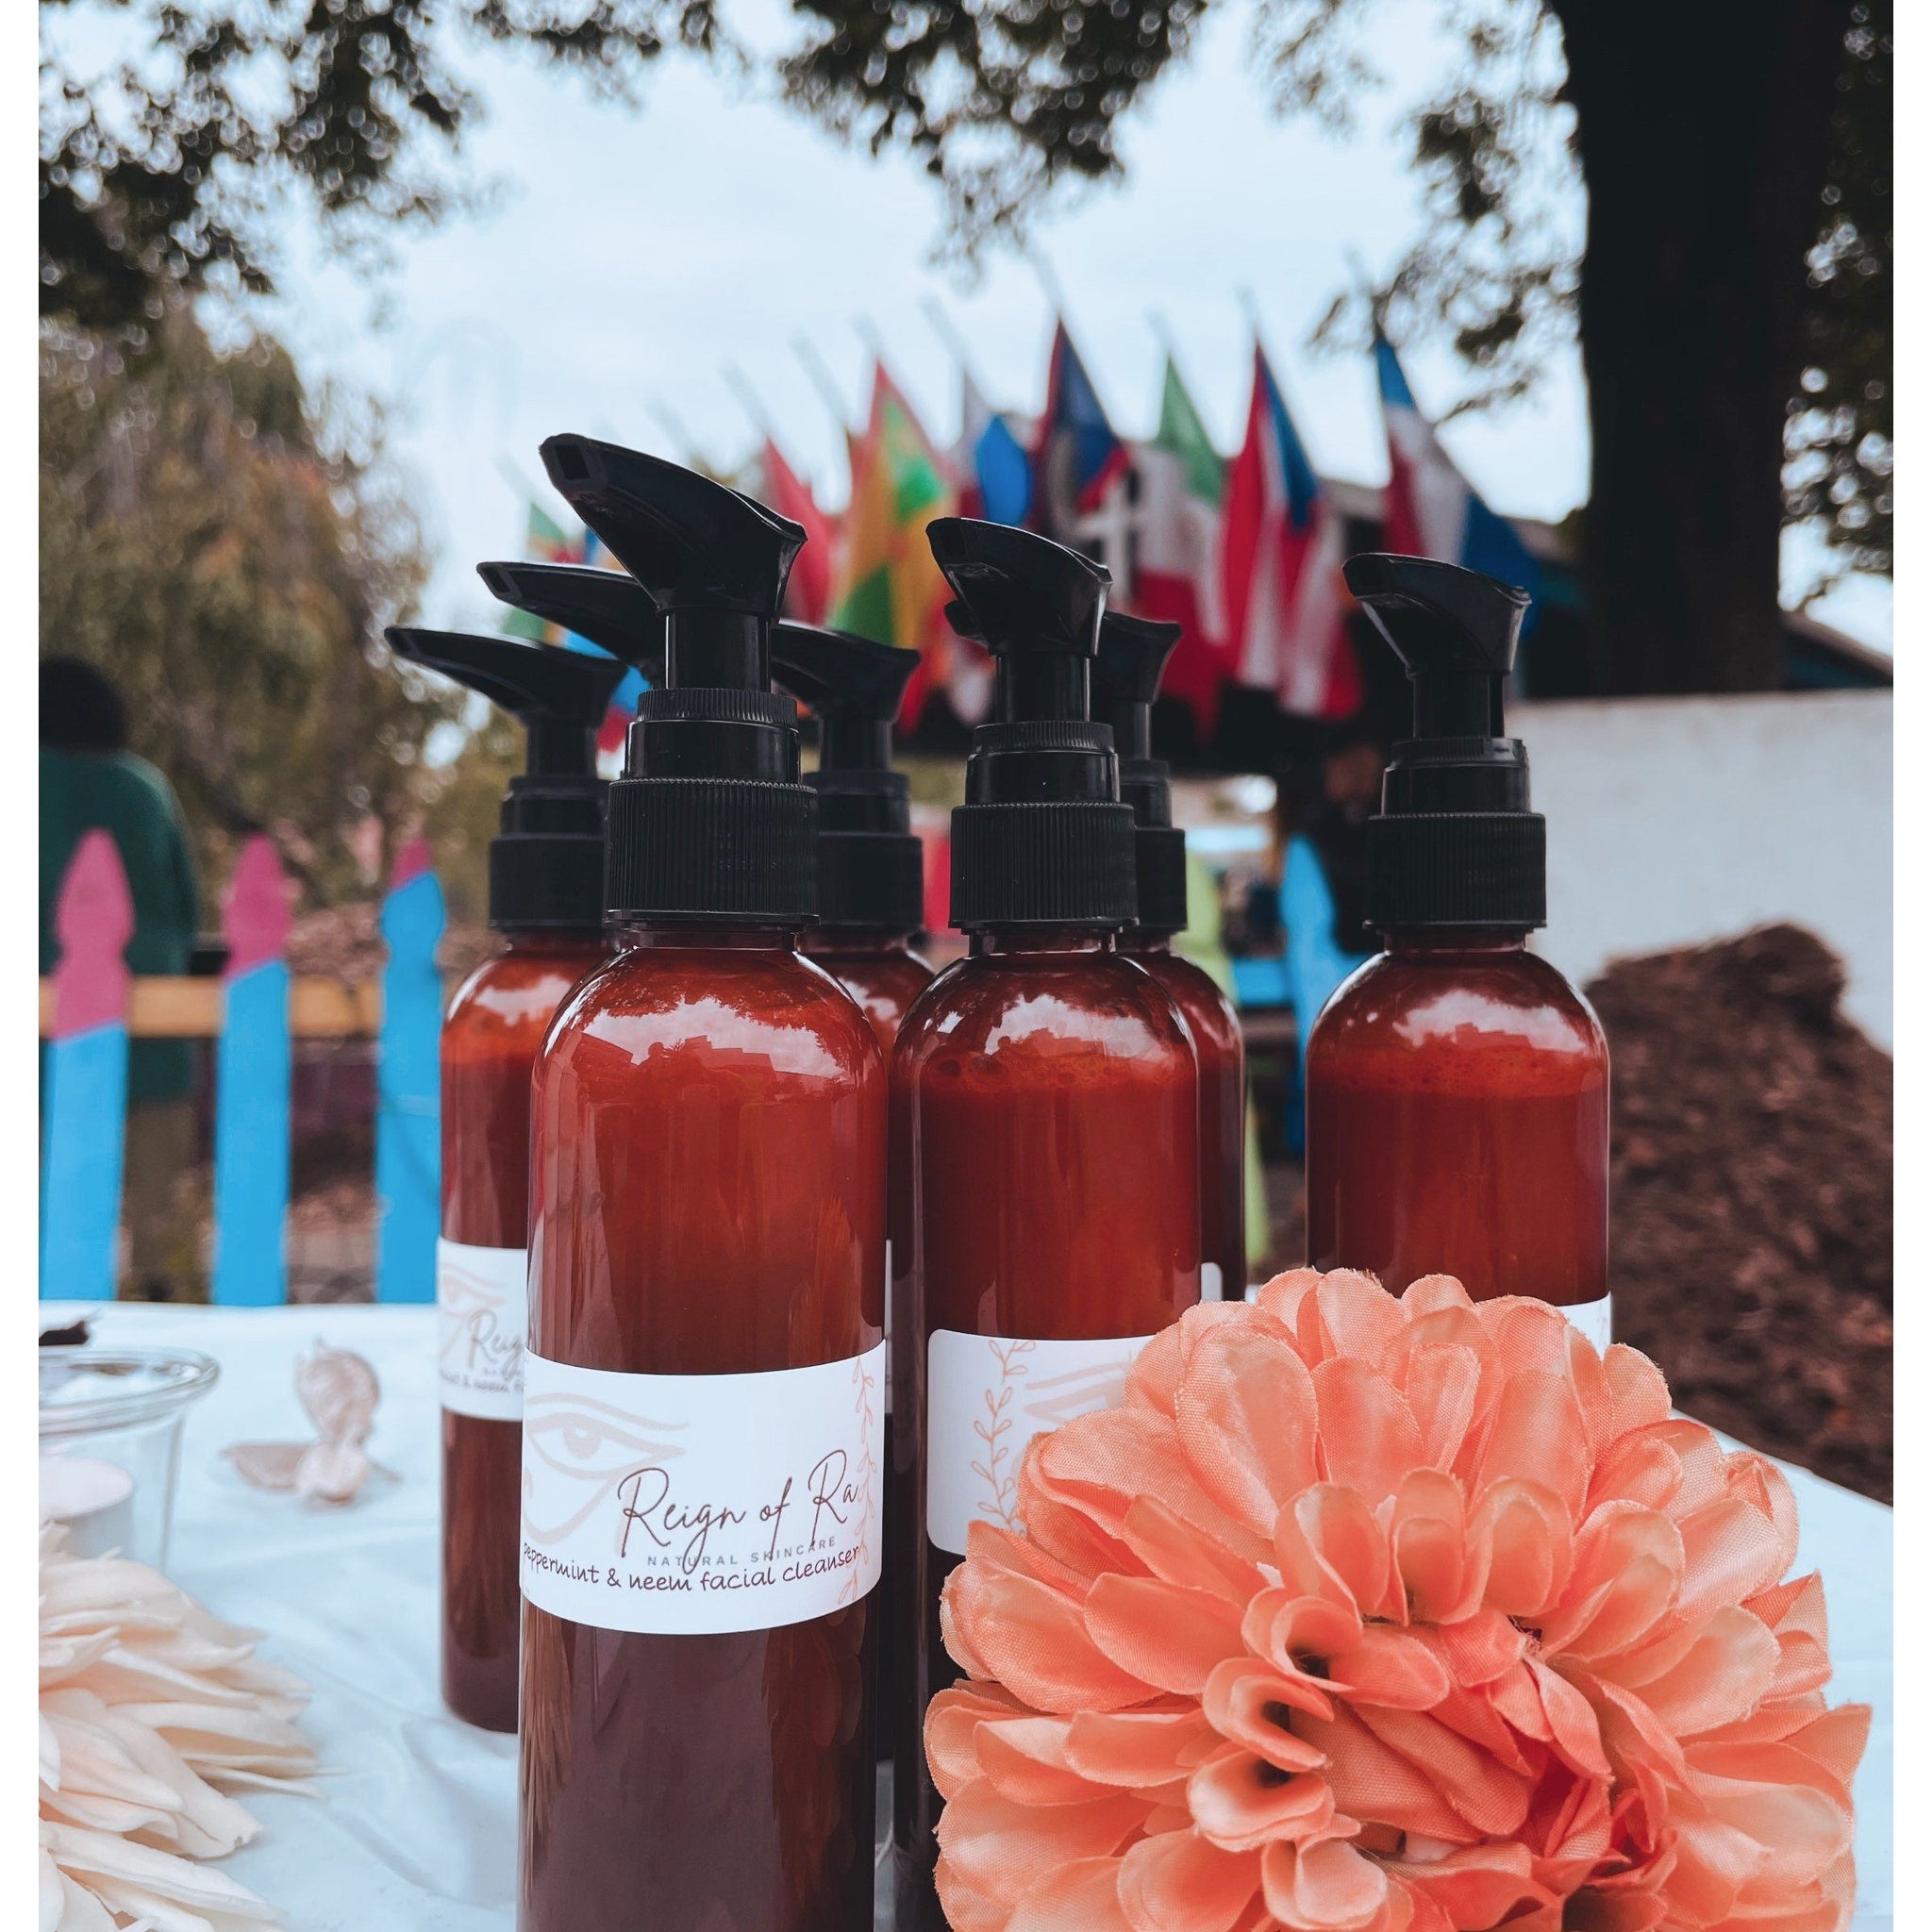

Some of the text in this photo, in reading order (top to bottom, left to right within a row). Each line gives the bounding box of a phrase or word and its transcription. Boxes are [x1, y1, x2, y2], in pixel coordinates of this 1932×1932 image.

[467, 1308, 524, 1381] Reig
[617, 1449, 858, 1574] Reign of Ra
[524, 1541, 859, 1591] peppermint & neem facial cleanser
[647, 1536, 836, 1567] NATURAL SKINCARE
